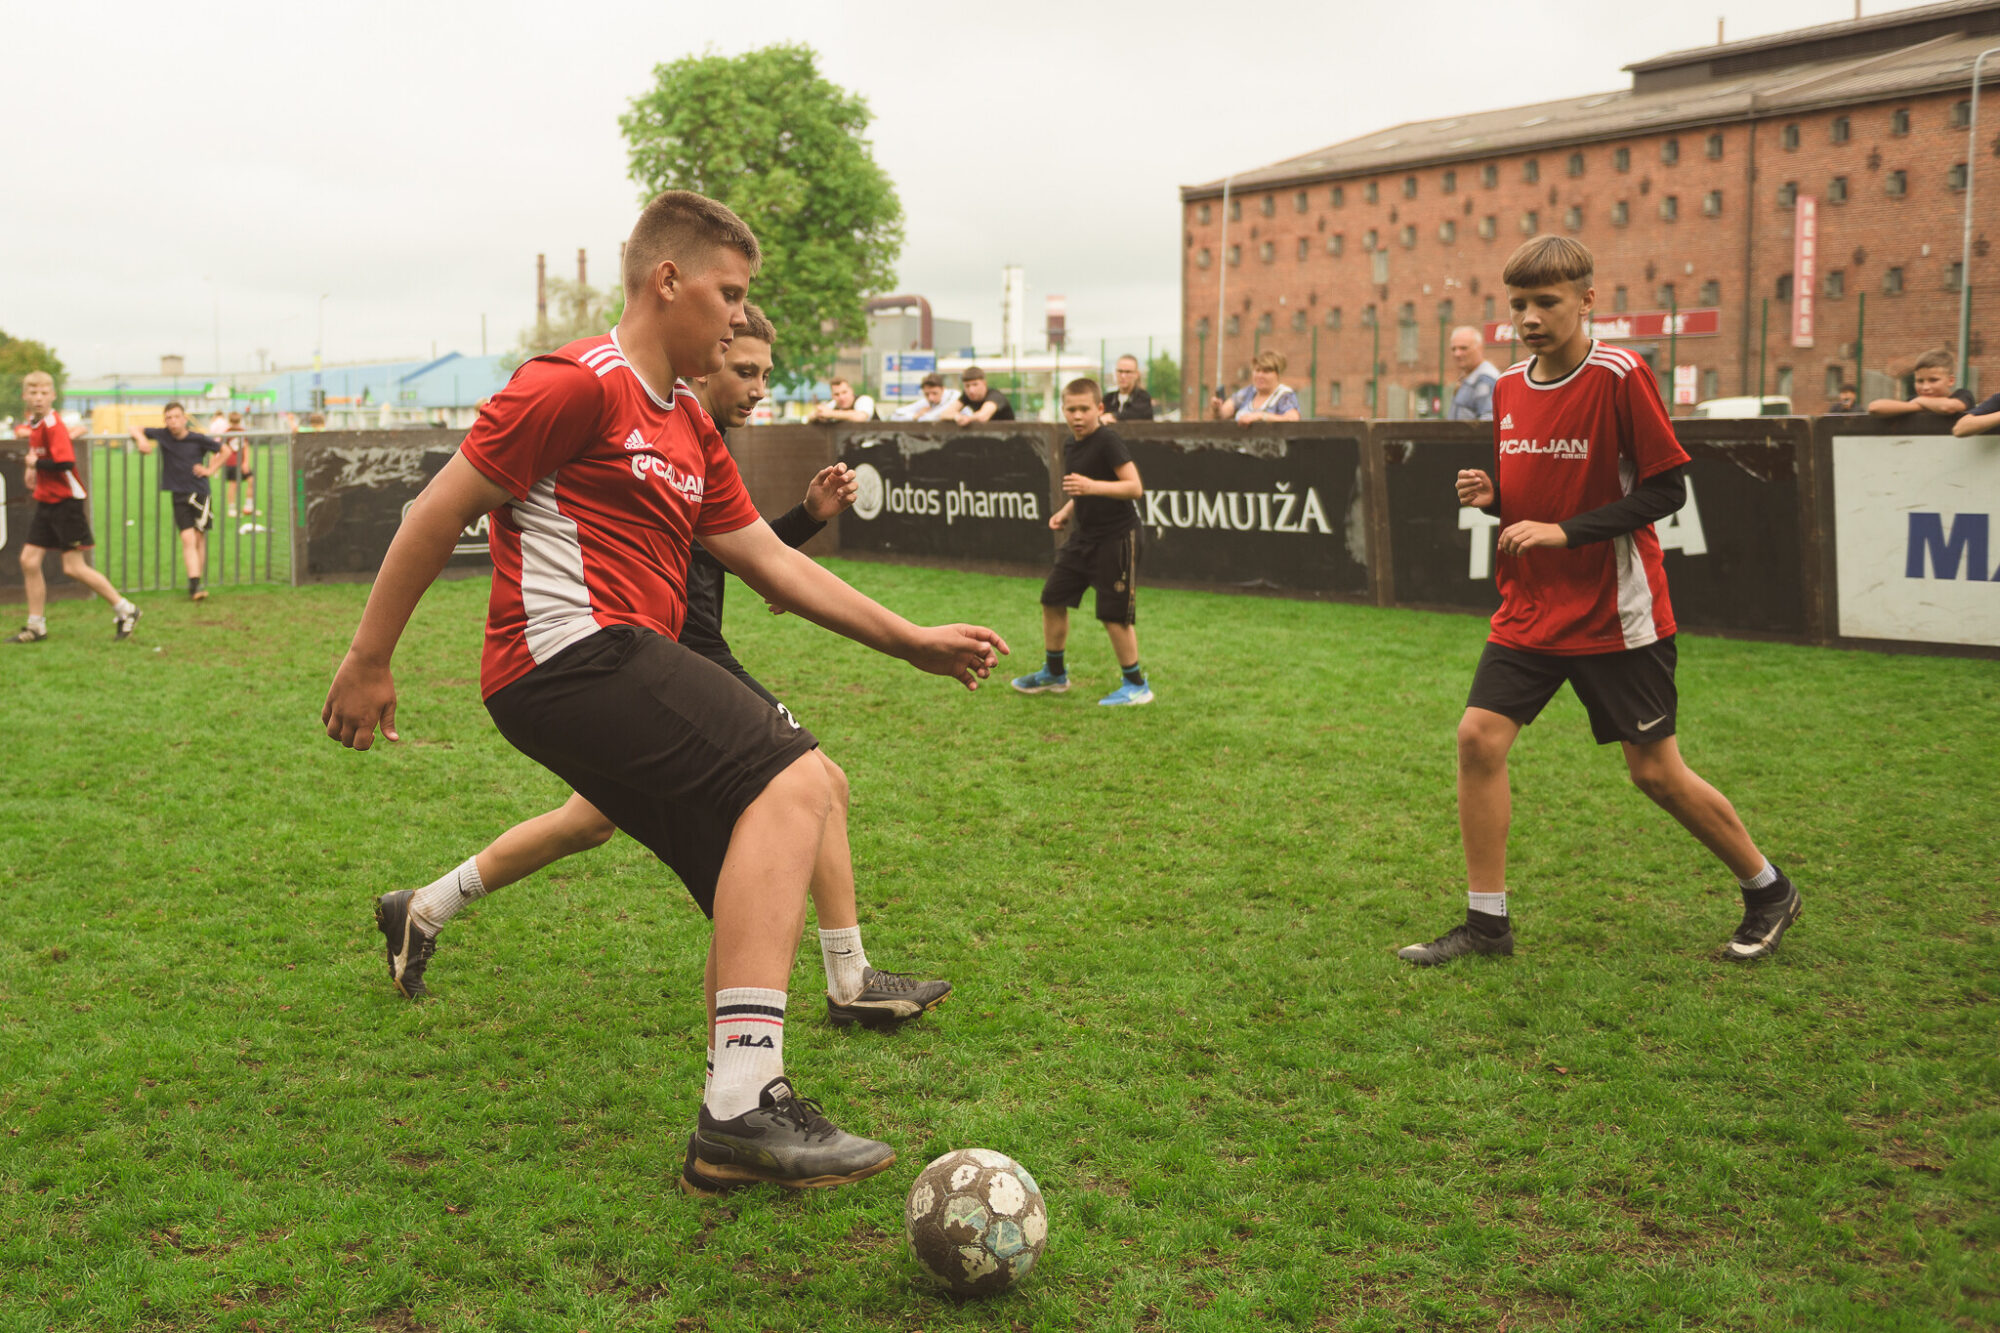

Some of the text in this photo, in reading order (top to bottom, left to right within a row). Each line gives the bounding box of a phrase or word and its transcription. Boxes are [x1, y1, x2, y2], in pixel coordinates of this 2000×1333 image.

[1505, 439, 1589, 455] CALJAN
[885, 477, 1040, 526] lotos pharma
[1133, 481, 1334, 540] ĶUMUIŽA
[1905, 512, 2000, 583] M
[725, 1033, 775, 1049] FILA
